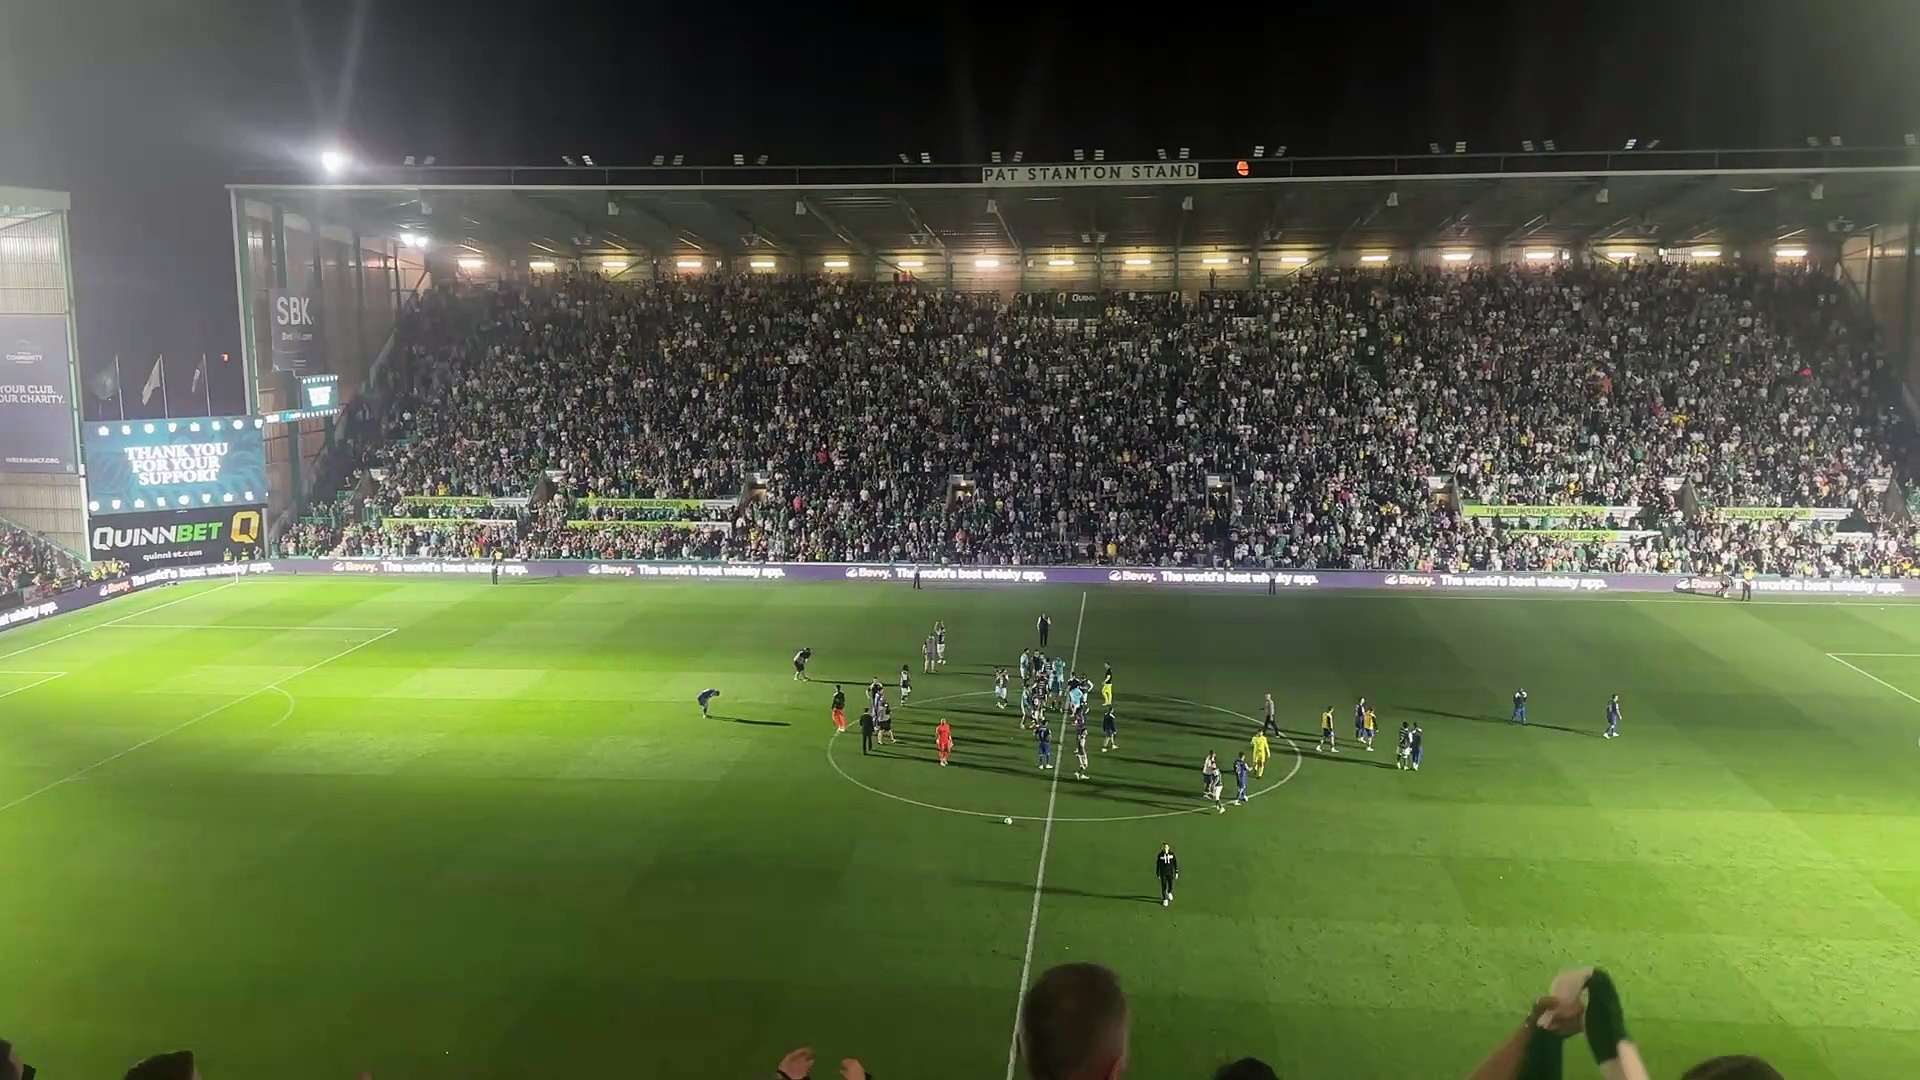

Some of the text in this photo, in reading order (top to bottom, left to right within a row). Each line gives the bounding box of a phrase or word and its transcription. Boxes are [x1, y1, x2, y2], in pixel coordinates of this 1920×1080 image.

[984, 165, 1197, 181] PAT STANTON STAND
[276, 296, 313, 326] SBK
[0, 385, 56, 394] YOUR CLUB.
[20, 394, 66, 404] CHARITY.
[123, 442, 229, 461] THANK YOU
[131, 455, 221, 473] FOR YOUR
[138, 468, 219, 486] SUPPORT
[231, 510, 260, 544] Q
[142, 549, 203, 561] quinnet.com
[381, 561, 401, 570] The
[442, 562, 466, 571] best
[600, 564, 786, 579] Bevvy. The world's best whisky app.
[859, 568, 892, 580] Bevvy.
[919, 568, 957, 578] world's
[958, 569, 982, 579] best
[983, 570, 1021, 582] whisky
[1022, 571, 1047, 582] app.
[1122, 572, 1157, 583] Bevvy.
[1160, 571, 1183, 582] The
[1184, 572, 1224, 583] world's
[1225, 573, 1250, 583] best
[1293, 575, 1319, 586] app.
[1399, 575, 1608, 590] Bevvy. The world's best whisky app.
[1734, 580, 1757, 590] Te
[1803, 581, 1831, 591] best
[1831, 581, 1876, 594] whisky
